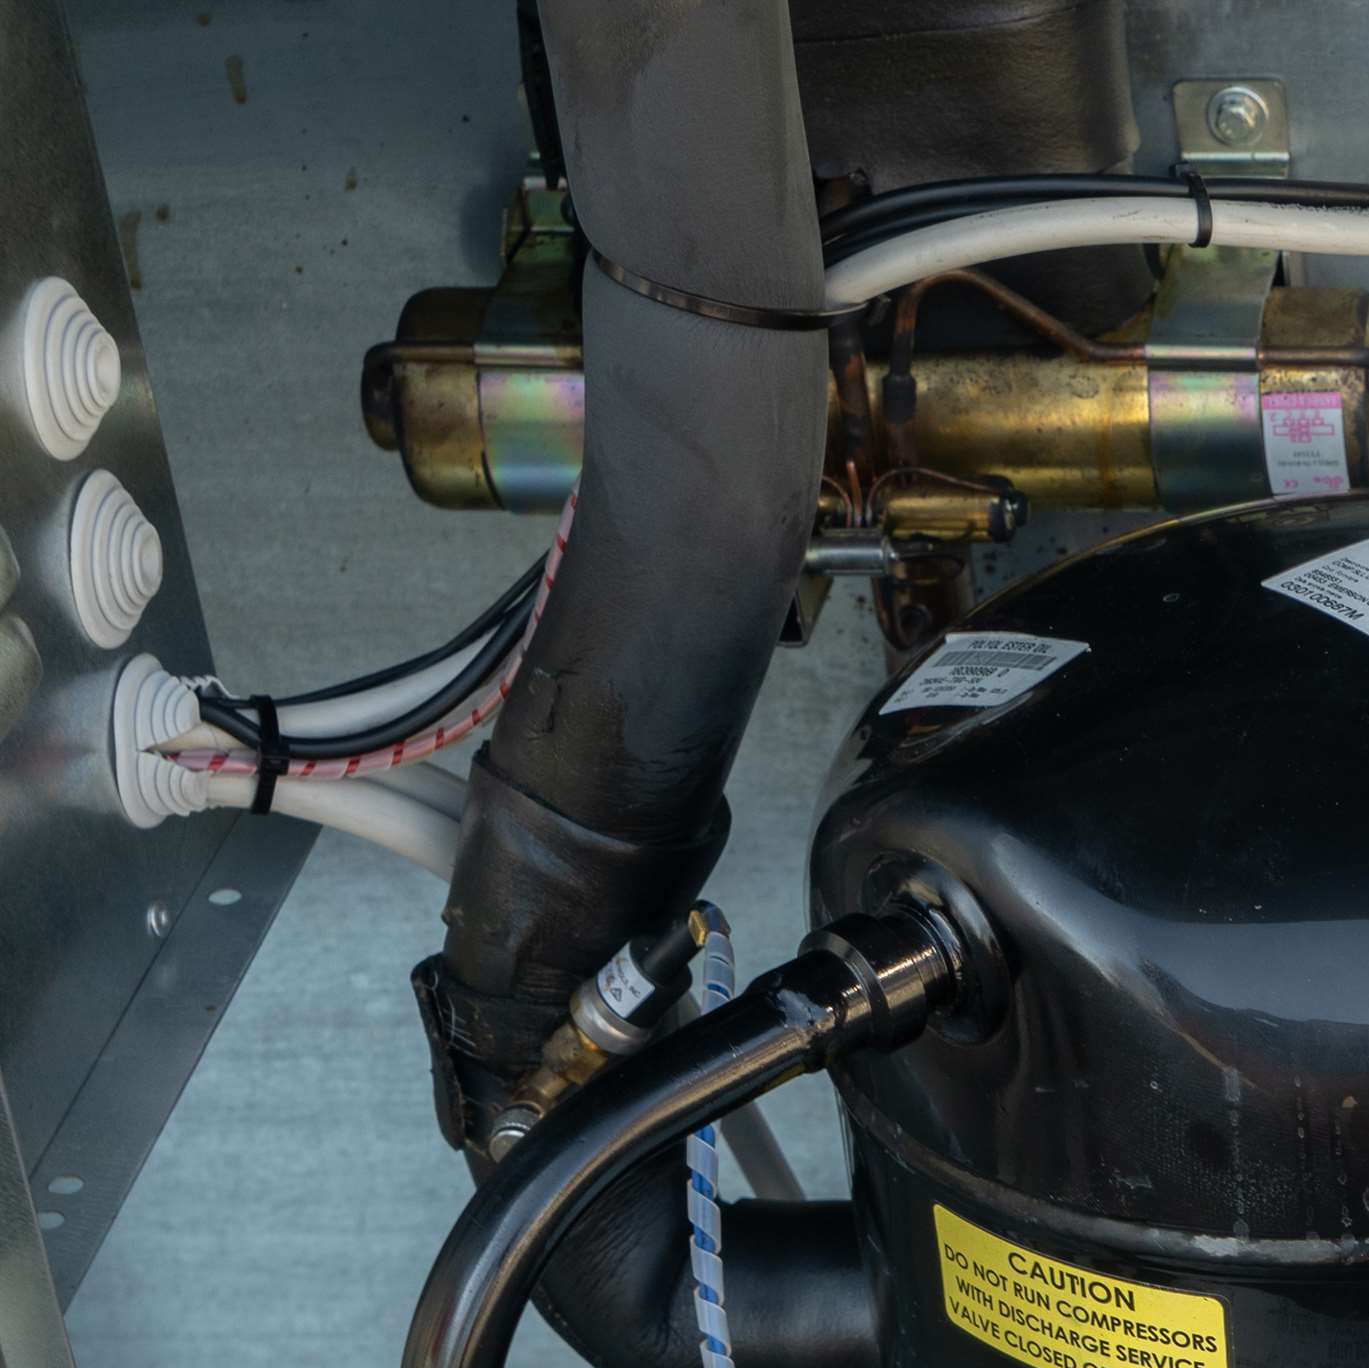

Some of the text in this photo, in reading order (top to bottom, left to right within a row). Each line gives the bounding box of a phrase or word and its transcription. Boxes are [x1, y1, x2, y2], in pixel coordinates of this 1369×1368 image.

[944, 1243, 1218, 1353] DO NOT RUN COMPRESSORS
[956, 1276, 994, 1311] WITH
[999, 1300, 1111, 1358] DISCHARGE
[1008, 1252, 1136, 1312] CAUTION
[949, 1296, 1000, 1340] VALVE
